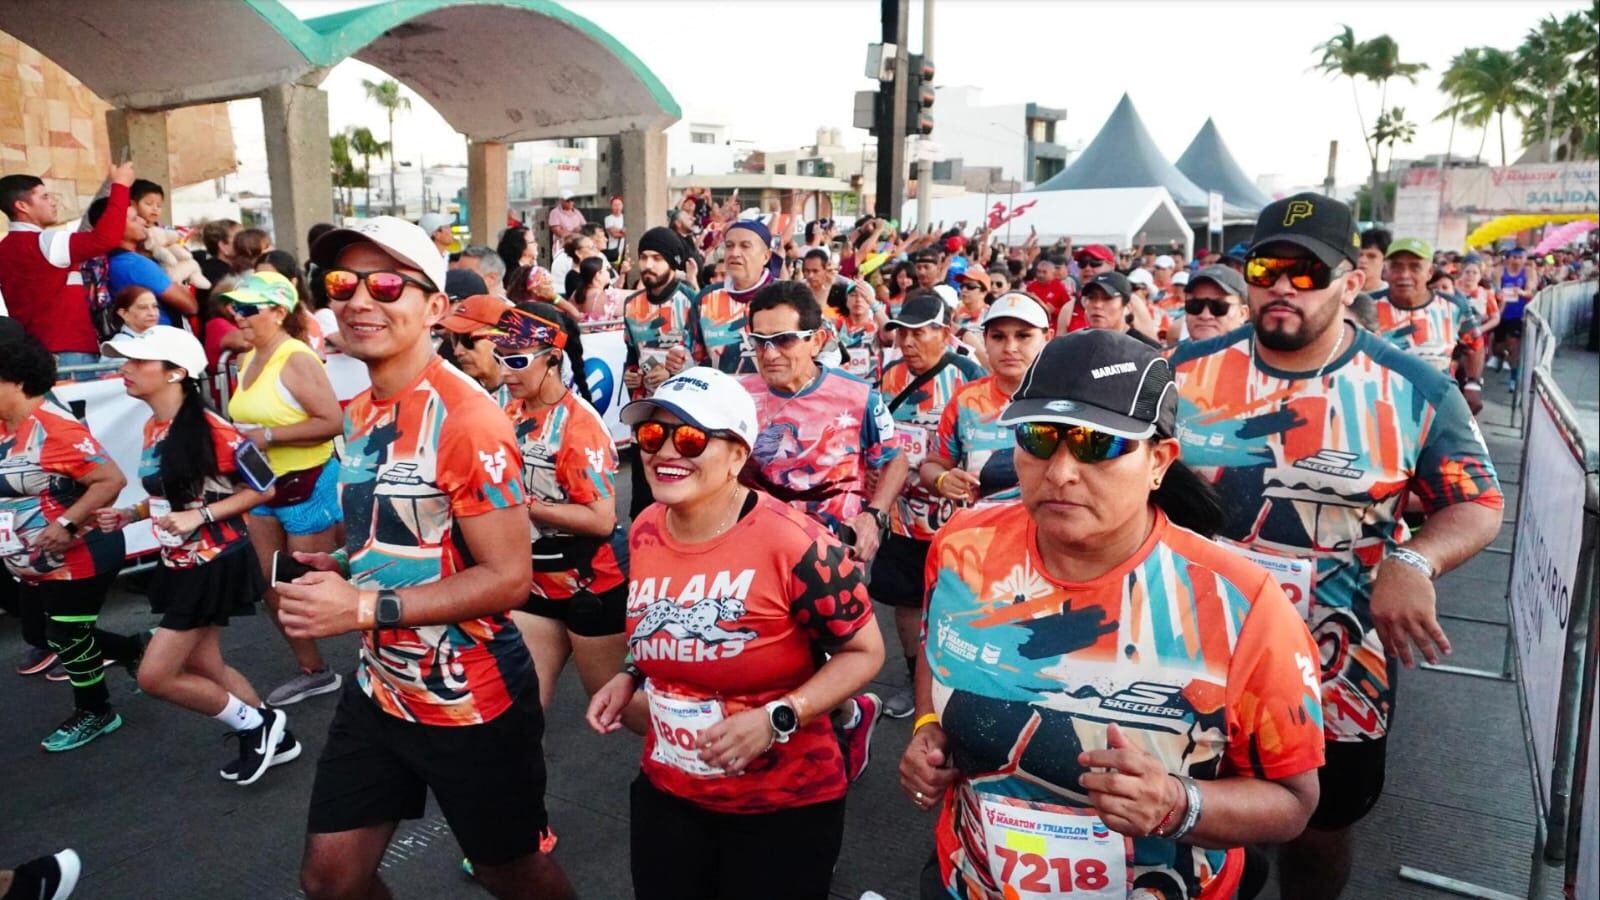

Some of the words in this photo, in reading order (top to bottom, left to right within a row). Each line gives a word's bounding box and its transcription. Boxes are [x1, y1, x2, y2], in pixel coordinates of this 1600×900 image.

[1527, 191, 1598, 204] SALIDA
[1283, 200, 1314, 227] P
[1091, 361, 1138, 380] MARATHON
[1298, 461, 1362, 478] SKECHERS
[627, 569, 755, 609] BALAM
[629, 637, 745, 662] UNNERS
[1103, 699, 1185, 716] SKECHERS
[994, 845, 1109, 894] 7218
